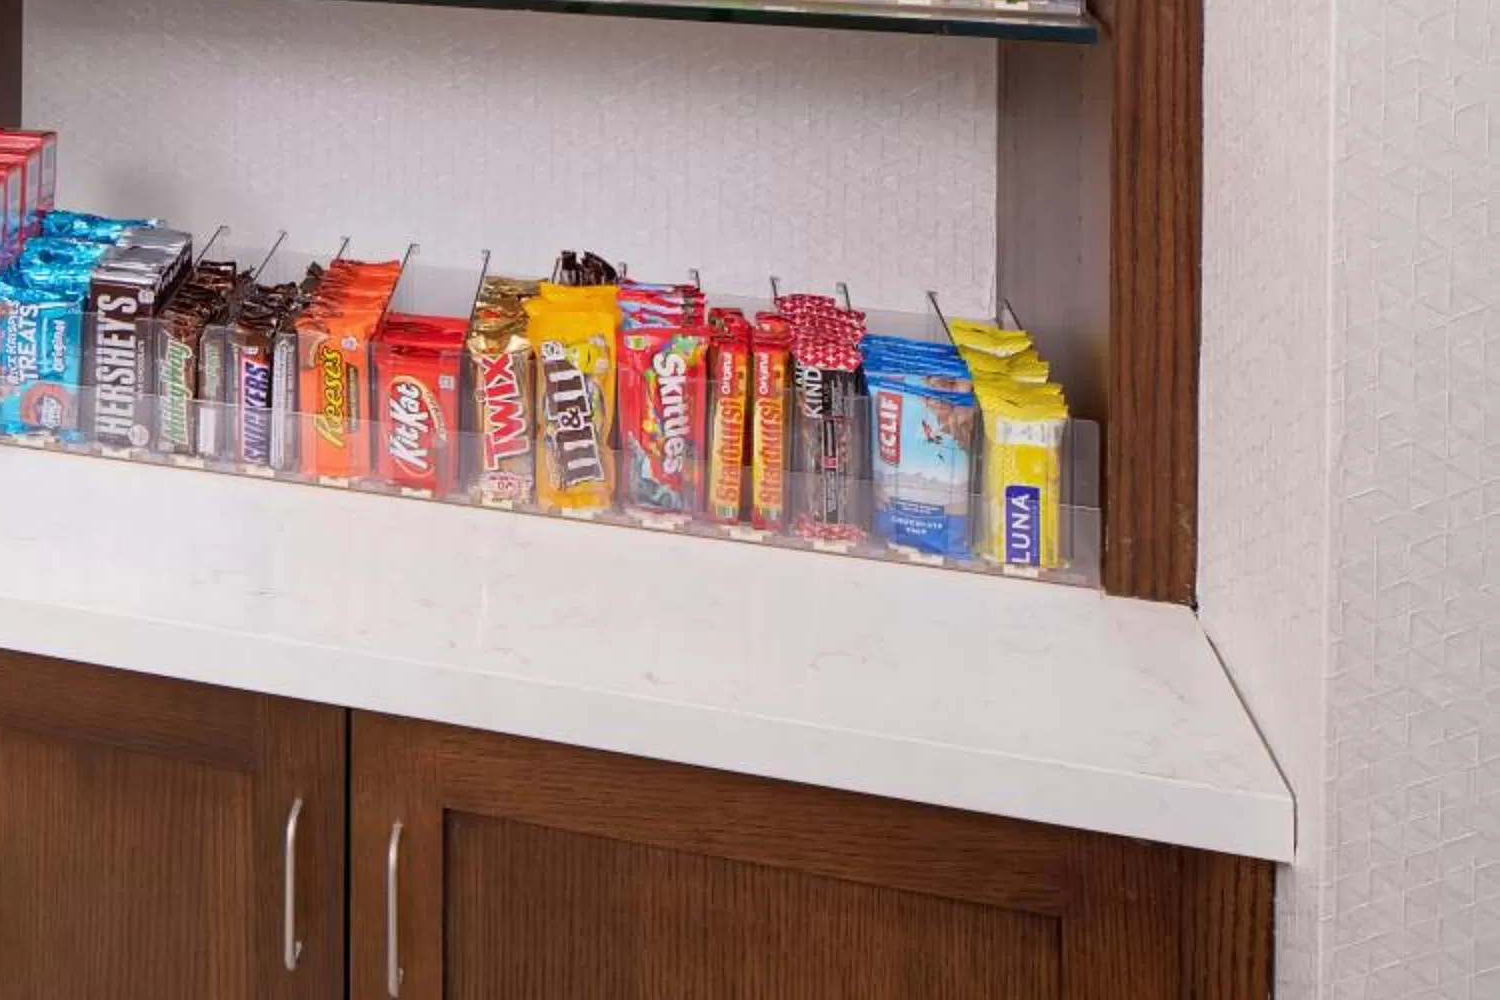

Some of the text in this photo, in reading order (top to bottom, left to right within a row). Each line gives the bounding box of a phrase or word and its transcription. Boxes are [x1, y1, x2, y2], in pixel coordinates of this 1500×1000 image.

[17, 303, 39, 382] TREATS
[95, 294, 138, 436] HERSHEY'S
[803, 366, 823, 419] KIND
[243, 361, 270, 463] SNICKERS
[314, 348, 344, 447] Reese's
[484, 353, 528, 470] TWIX
[652, 353, 692, 475] Skittles
[715, 398, 743, 503] Starburst
[1011, 493, 1030, 565] LUNA
